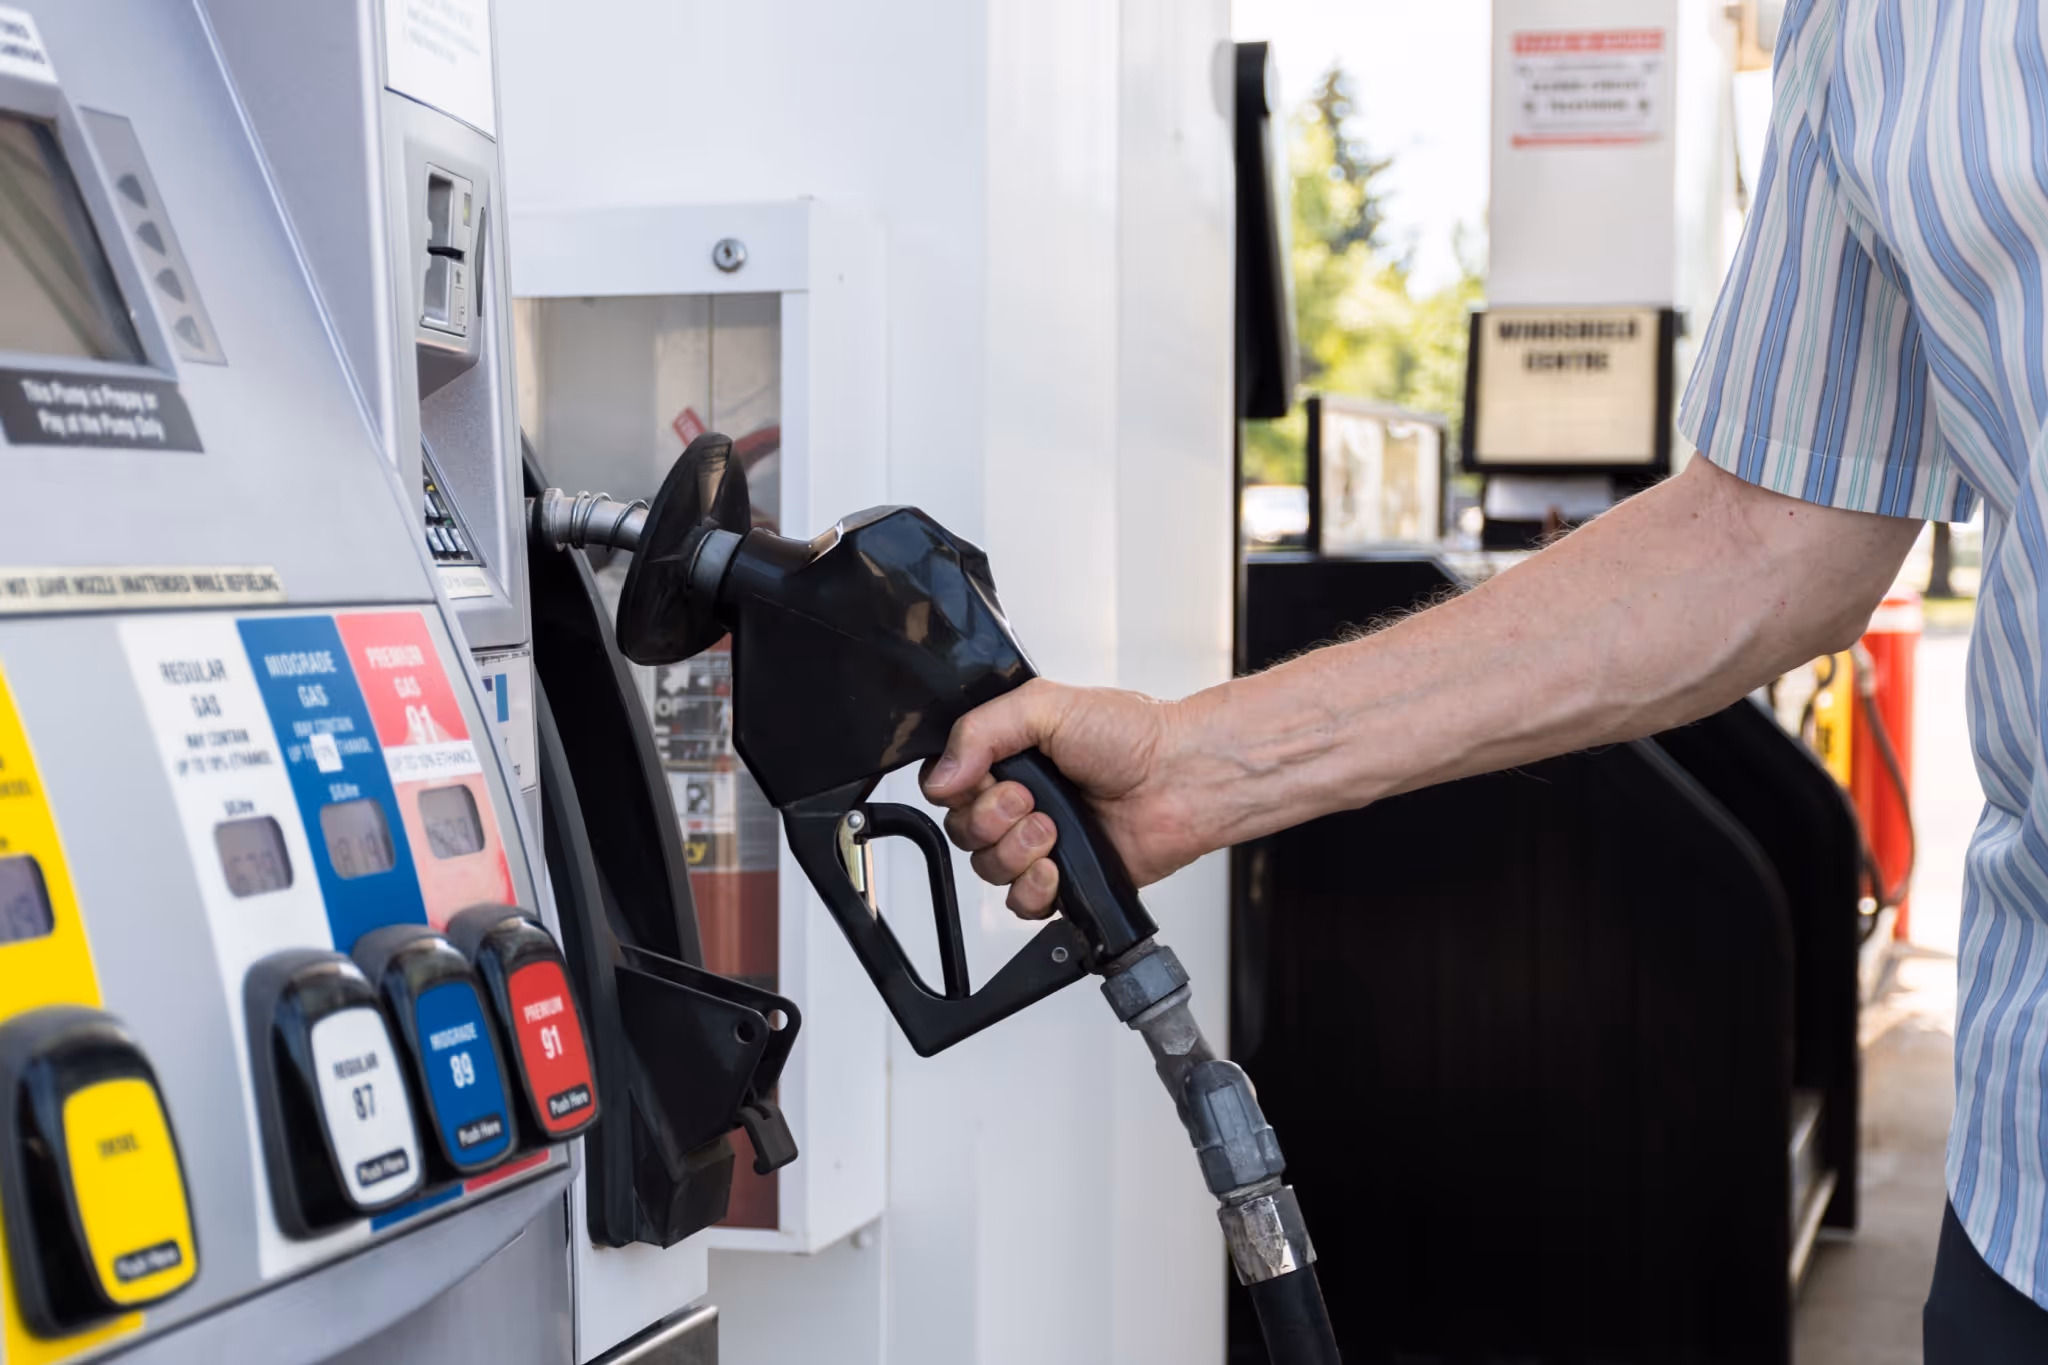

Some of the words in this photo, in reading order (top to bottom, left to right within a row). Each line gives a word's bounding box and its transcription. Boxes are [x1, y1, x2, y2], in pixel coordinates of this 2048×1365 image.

[158, 658, 228, 685] REGULAR
[263, 651, 338, 679] MIDGRADE
[364, 645, 425, 670] PREMIUM
[297, 684, 330, 708] GAS
[393, 675, 422, 699] GAS
[190, 694, 222, 718] GAS
[404, 704, 440, 745] 91
[522, 995, 565, 1024] PREMIUM
[429, 1021, 478, 1052] MIDGRADE
[540, 1024, 563, 1060] 91
[333, 1051, 380, 1080] REGULAR
[449, 1051, 476, 1089] 89
[353, 1083, 376, 1121] 87
[550, 1097, 571, 1116] Push
[569, 1089, 590, 1109] Here
[458, 1126, 481, 1147] Push
[479, 1118, 502, 1139] Here
